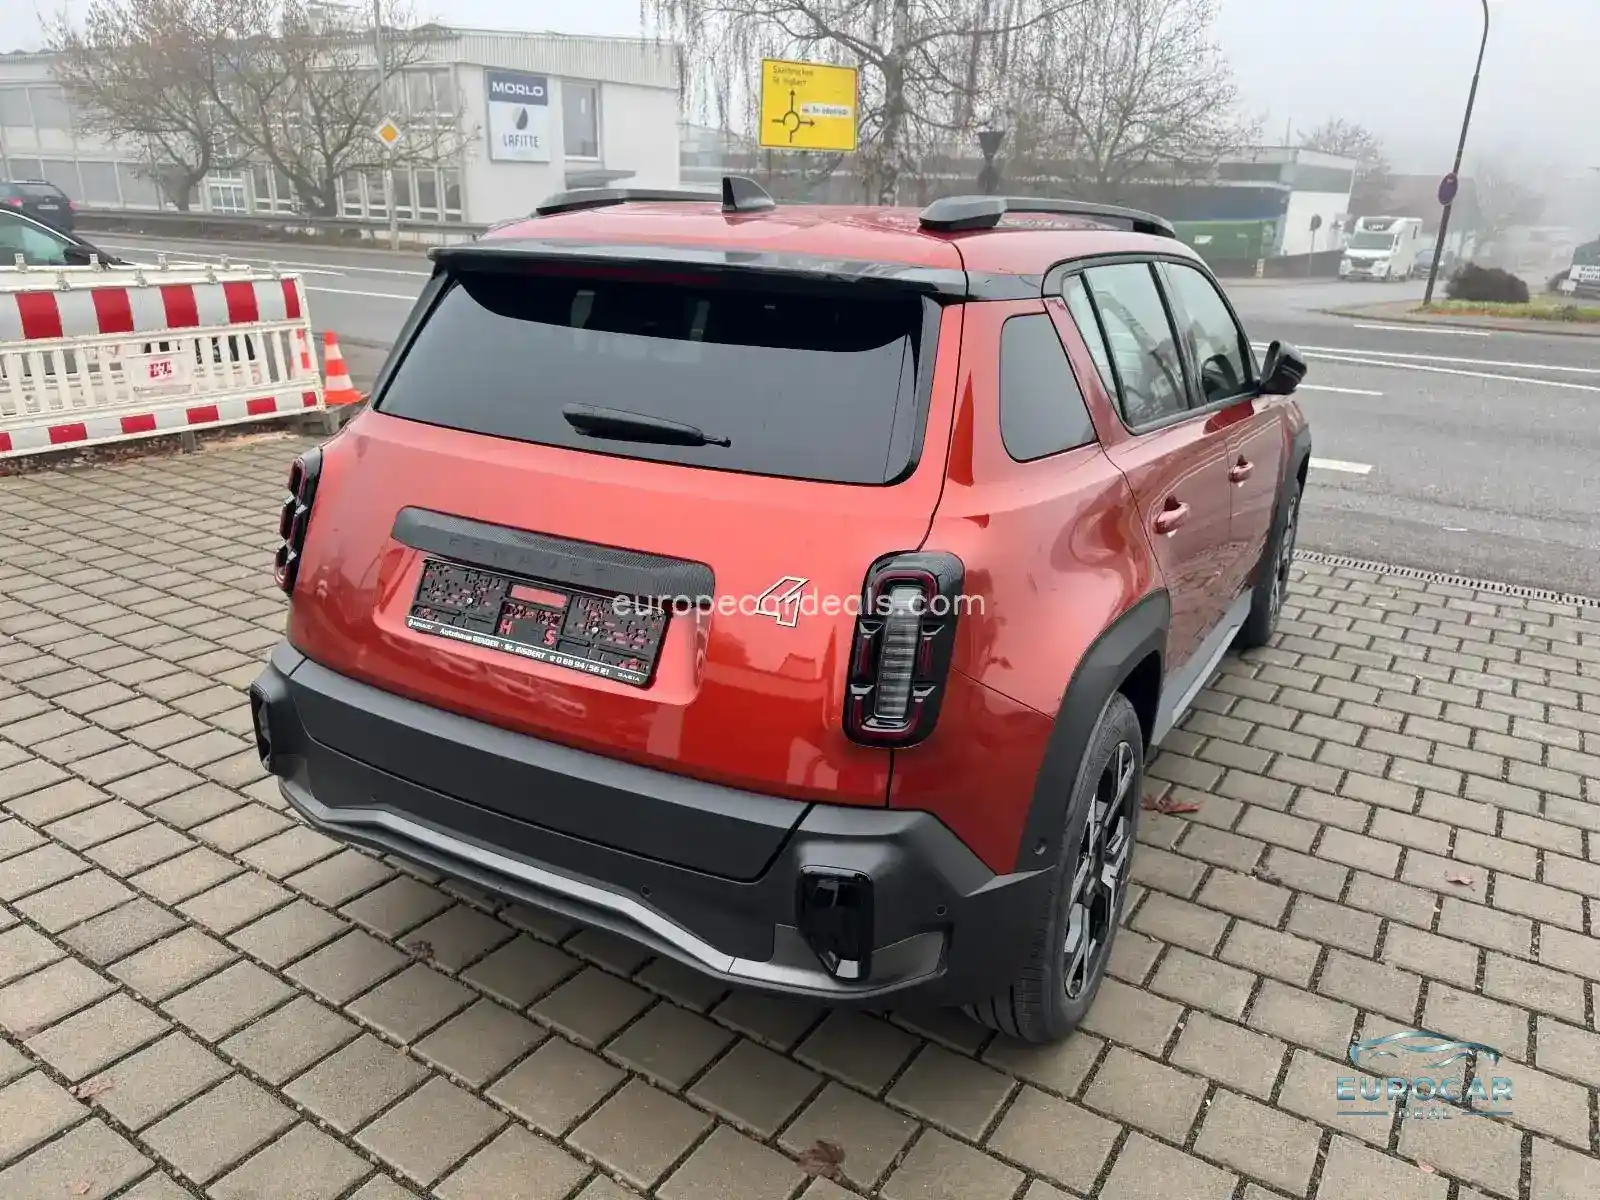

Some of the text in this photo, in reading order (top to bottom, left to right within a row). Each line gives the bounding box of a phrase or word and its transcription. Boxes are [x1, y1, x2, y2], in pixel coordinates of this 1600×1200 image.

[492, 81, 544, 97] MORLO
[503, 134, 540, 148] LAFITTE
[754, 575, 810, 628] 4
[440, 628, 472, 641] Autohaus
